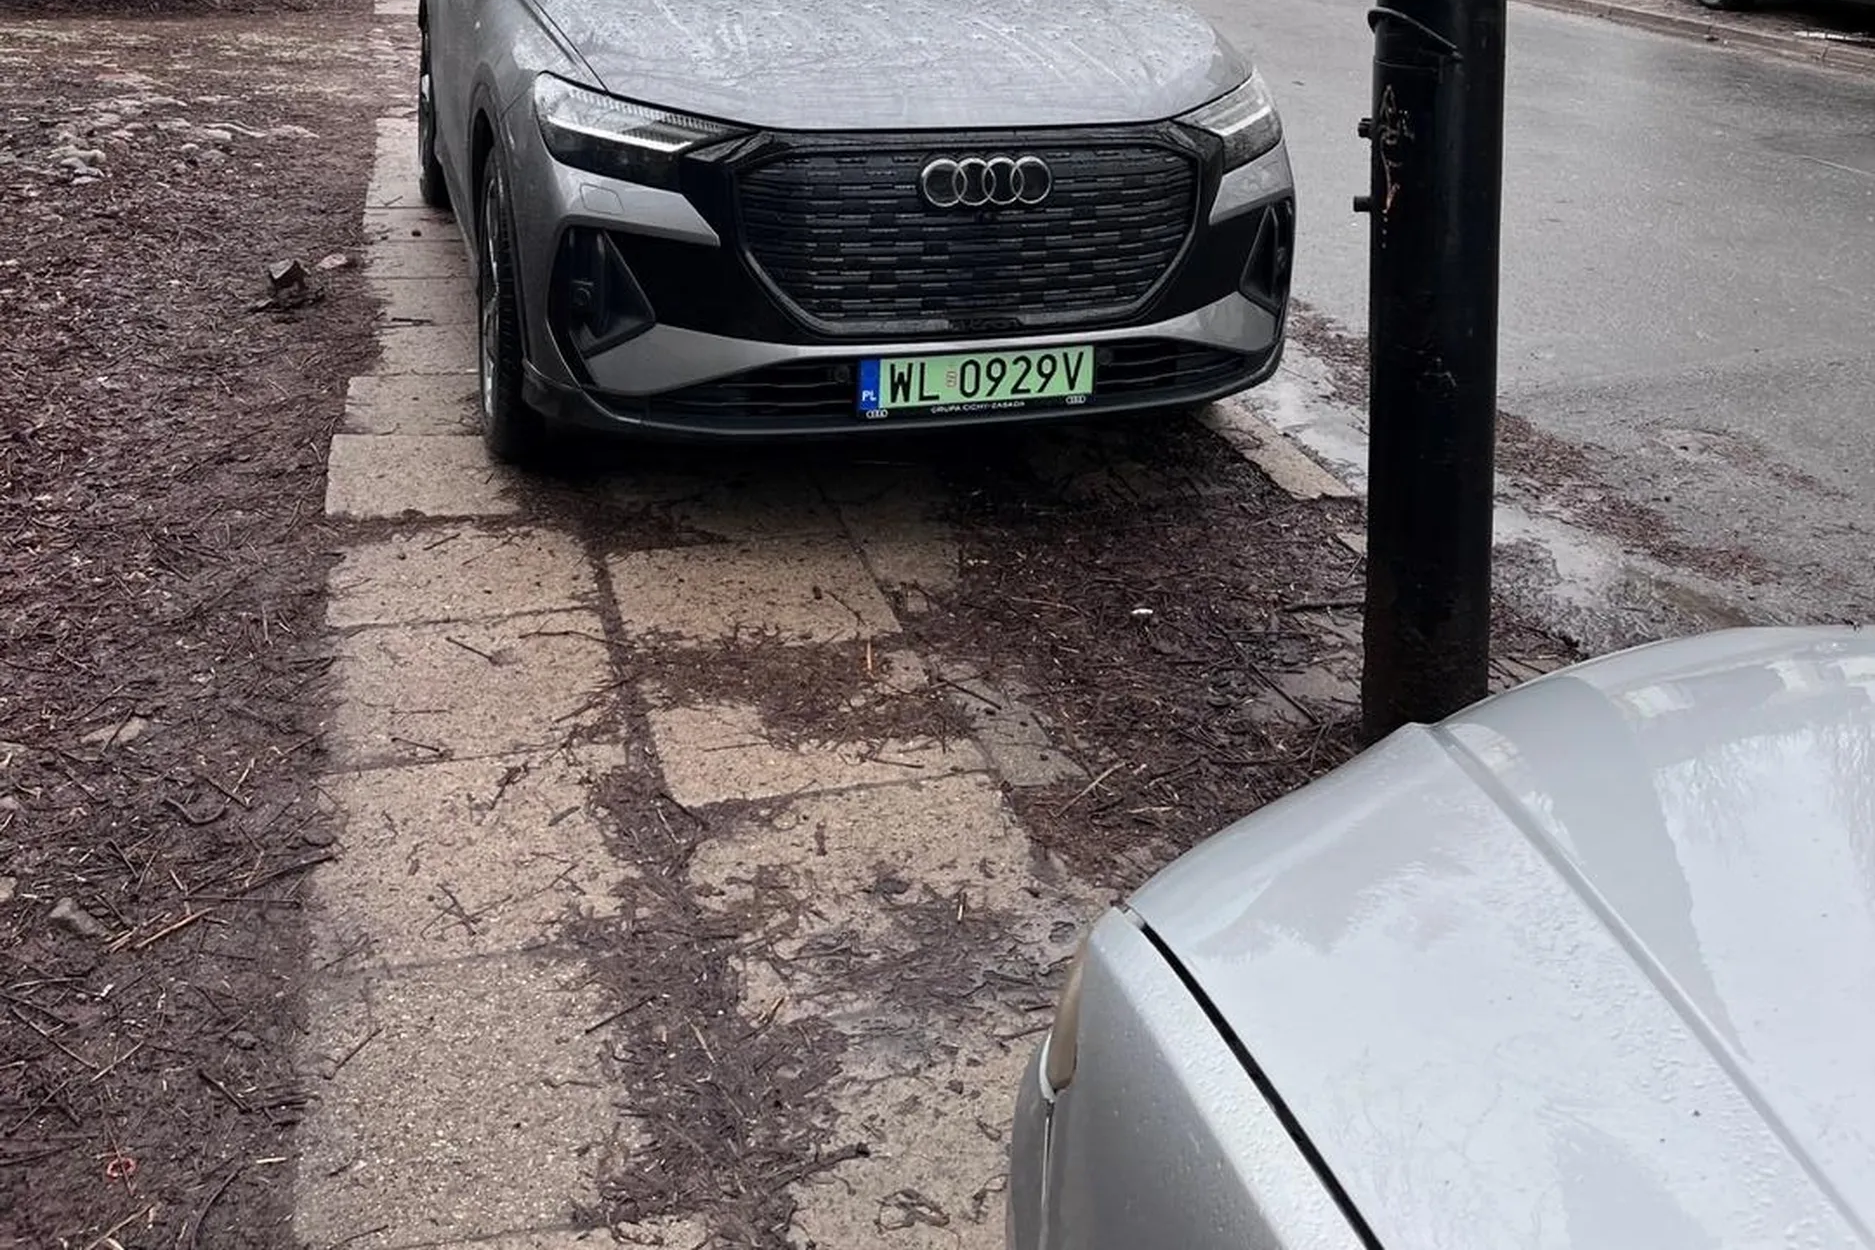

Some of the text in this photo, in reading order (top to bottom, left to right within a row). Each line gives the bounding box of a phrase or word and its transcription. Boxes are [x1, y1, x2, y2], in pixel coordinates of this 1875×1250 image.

[889, 351, 1084, 403] WL 0929V
[862, 390, 877, 401] PL
